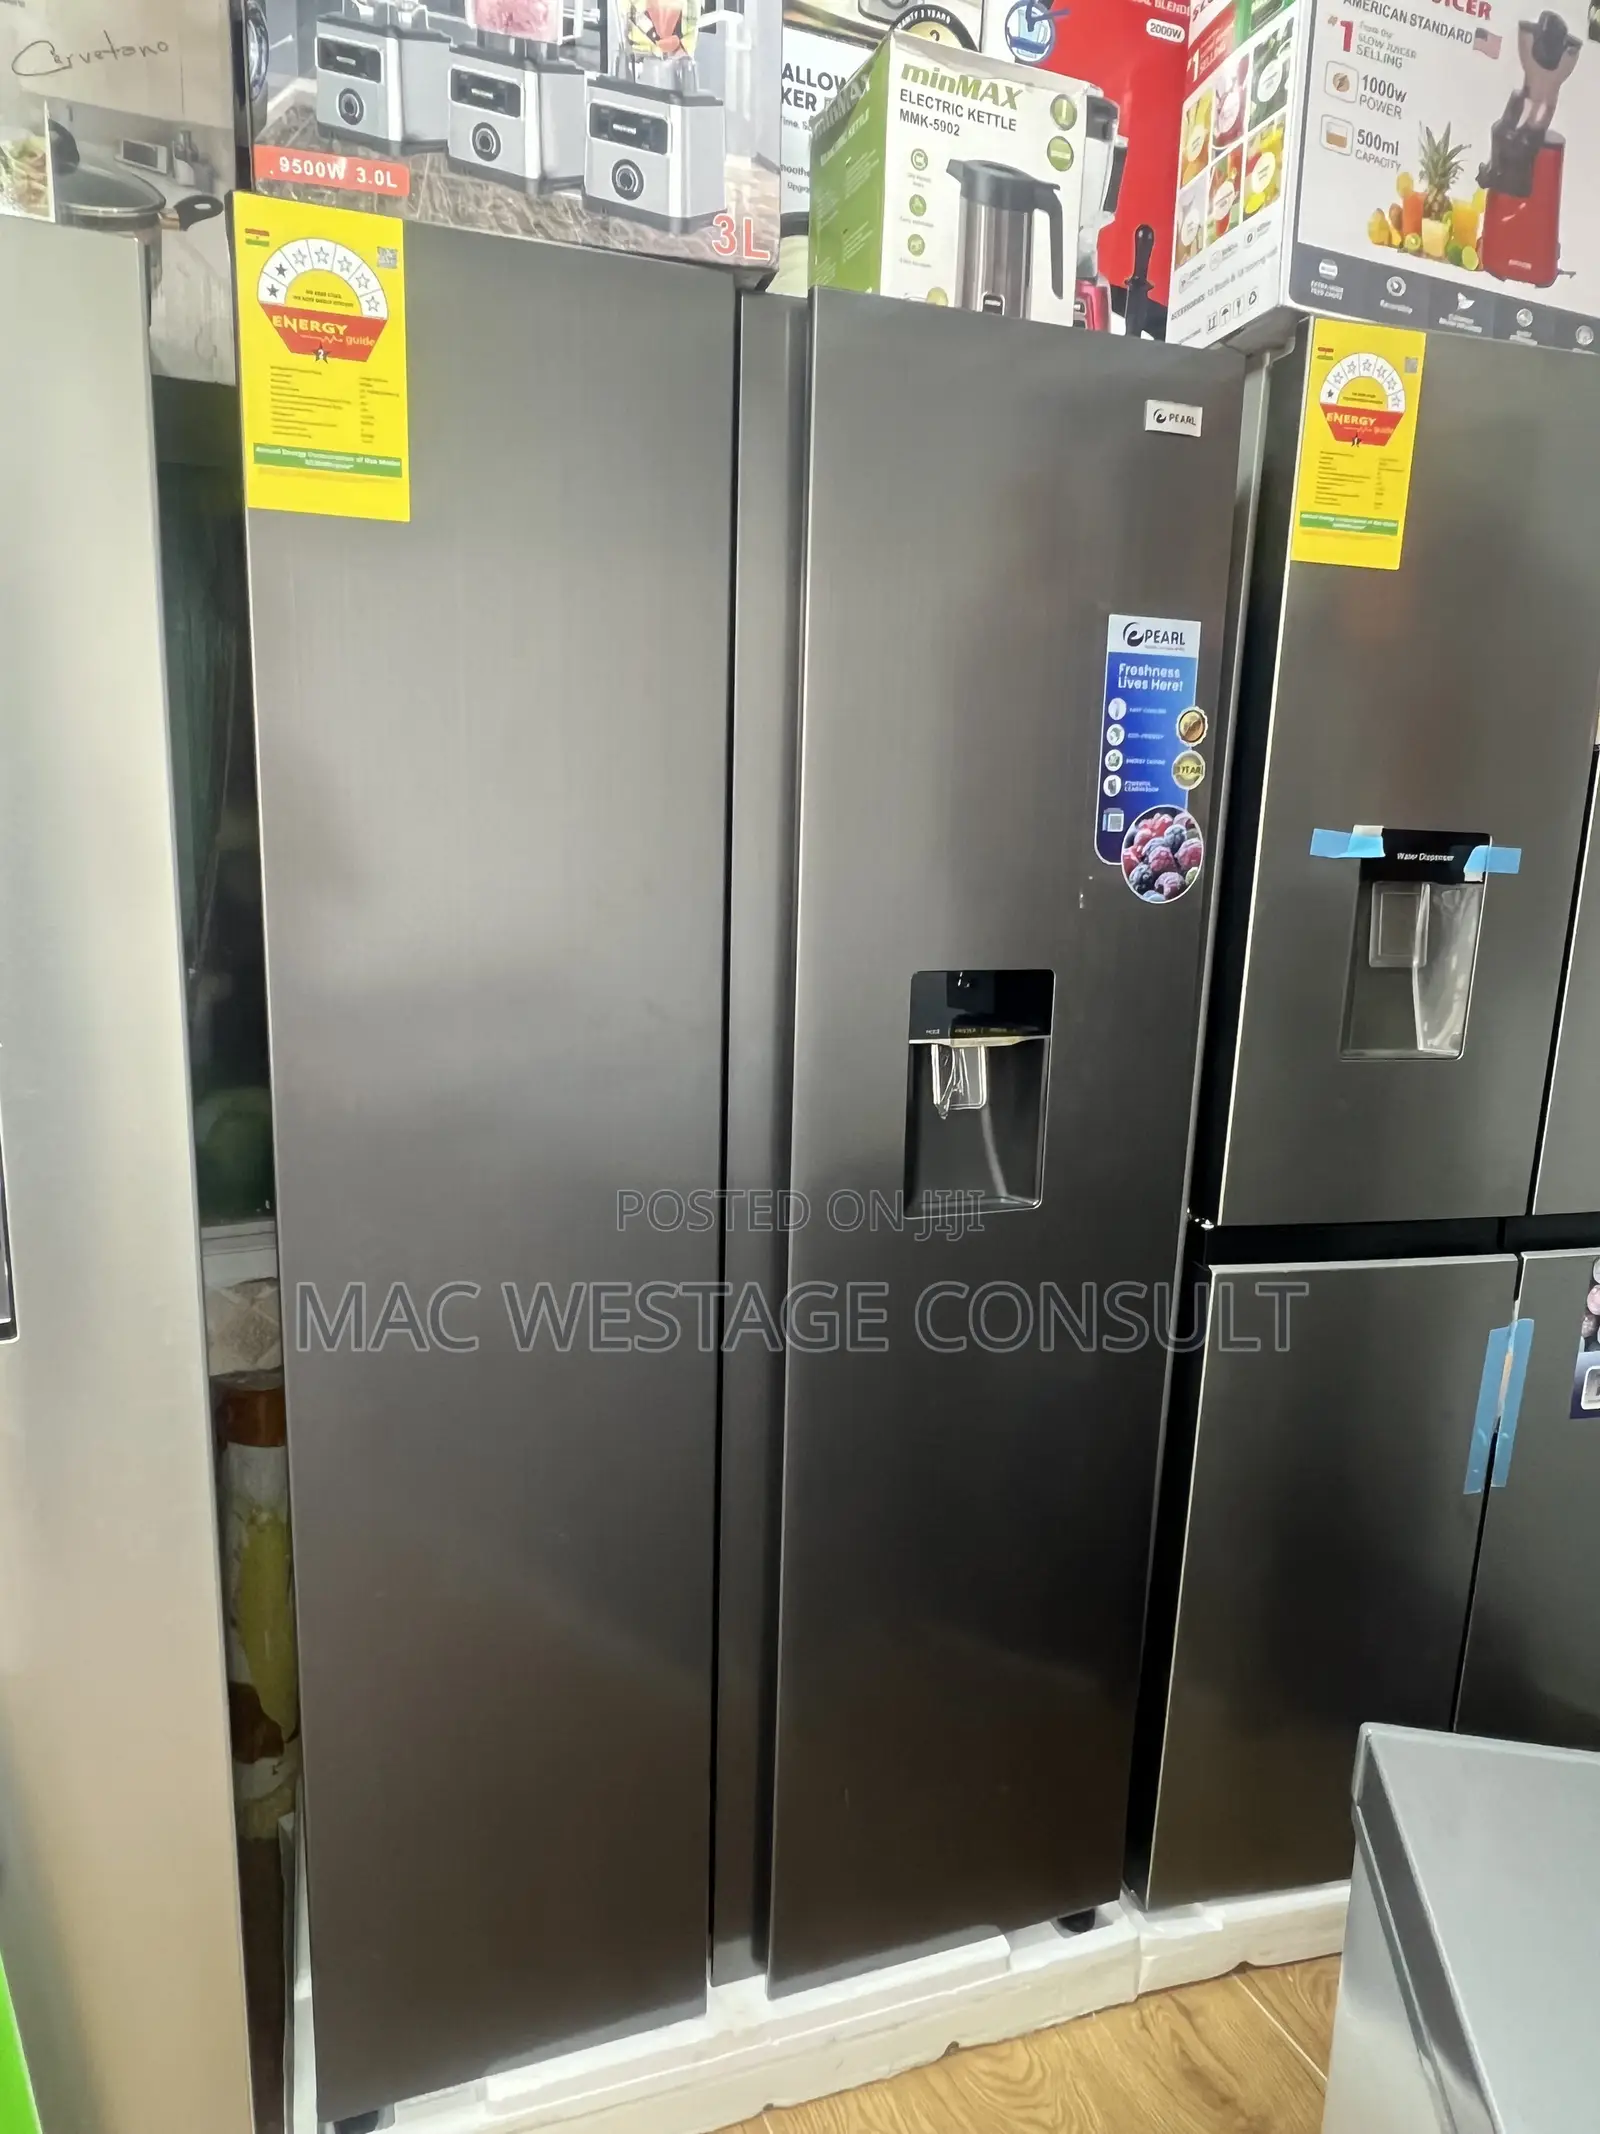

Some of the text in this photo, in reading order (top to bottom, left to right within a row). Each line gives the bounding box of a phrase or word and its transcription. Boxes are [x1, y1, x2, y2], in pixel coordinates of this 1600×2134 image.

[1150, 21, 1183, 40] 2000W
[1409, 13, 1474, 45] STANDARD
[1355, 44, 1403, 69] SELLING
[901, 63, 1023, 111] minMAX
[900, 88, 1018, 132] ELECTRIC KETTLE
[1359, 94, 1403, 120] POWER
[900, 108, 961, 137] MMK-5902
[1357, 128, 1400, 157] 500ml
[1354, 149, 1402, 171] CAPACITY
[279, 155, 398, 189] 9500W 3.0L
[272, 314, 348, 335] ENERGY
[345, 335, 376, 348] guide
[1168, 413, 1197, 426] PEARL
[1326, 411, 1377, 427] ENERGY
[1144, 629, 1186, 646] PEARL
[1118, 663, 1180, 679] Freshness
[1117, 676, 1184, 692] Lives Here!
[1396, 852, 1418, 861] Water
